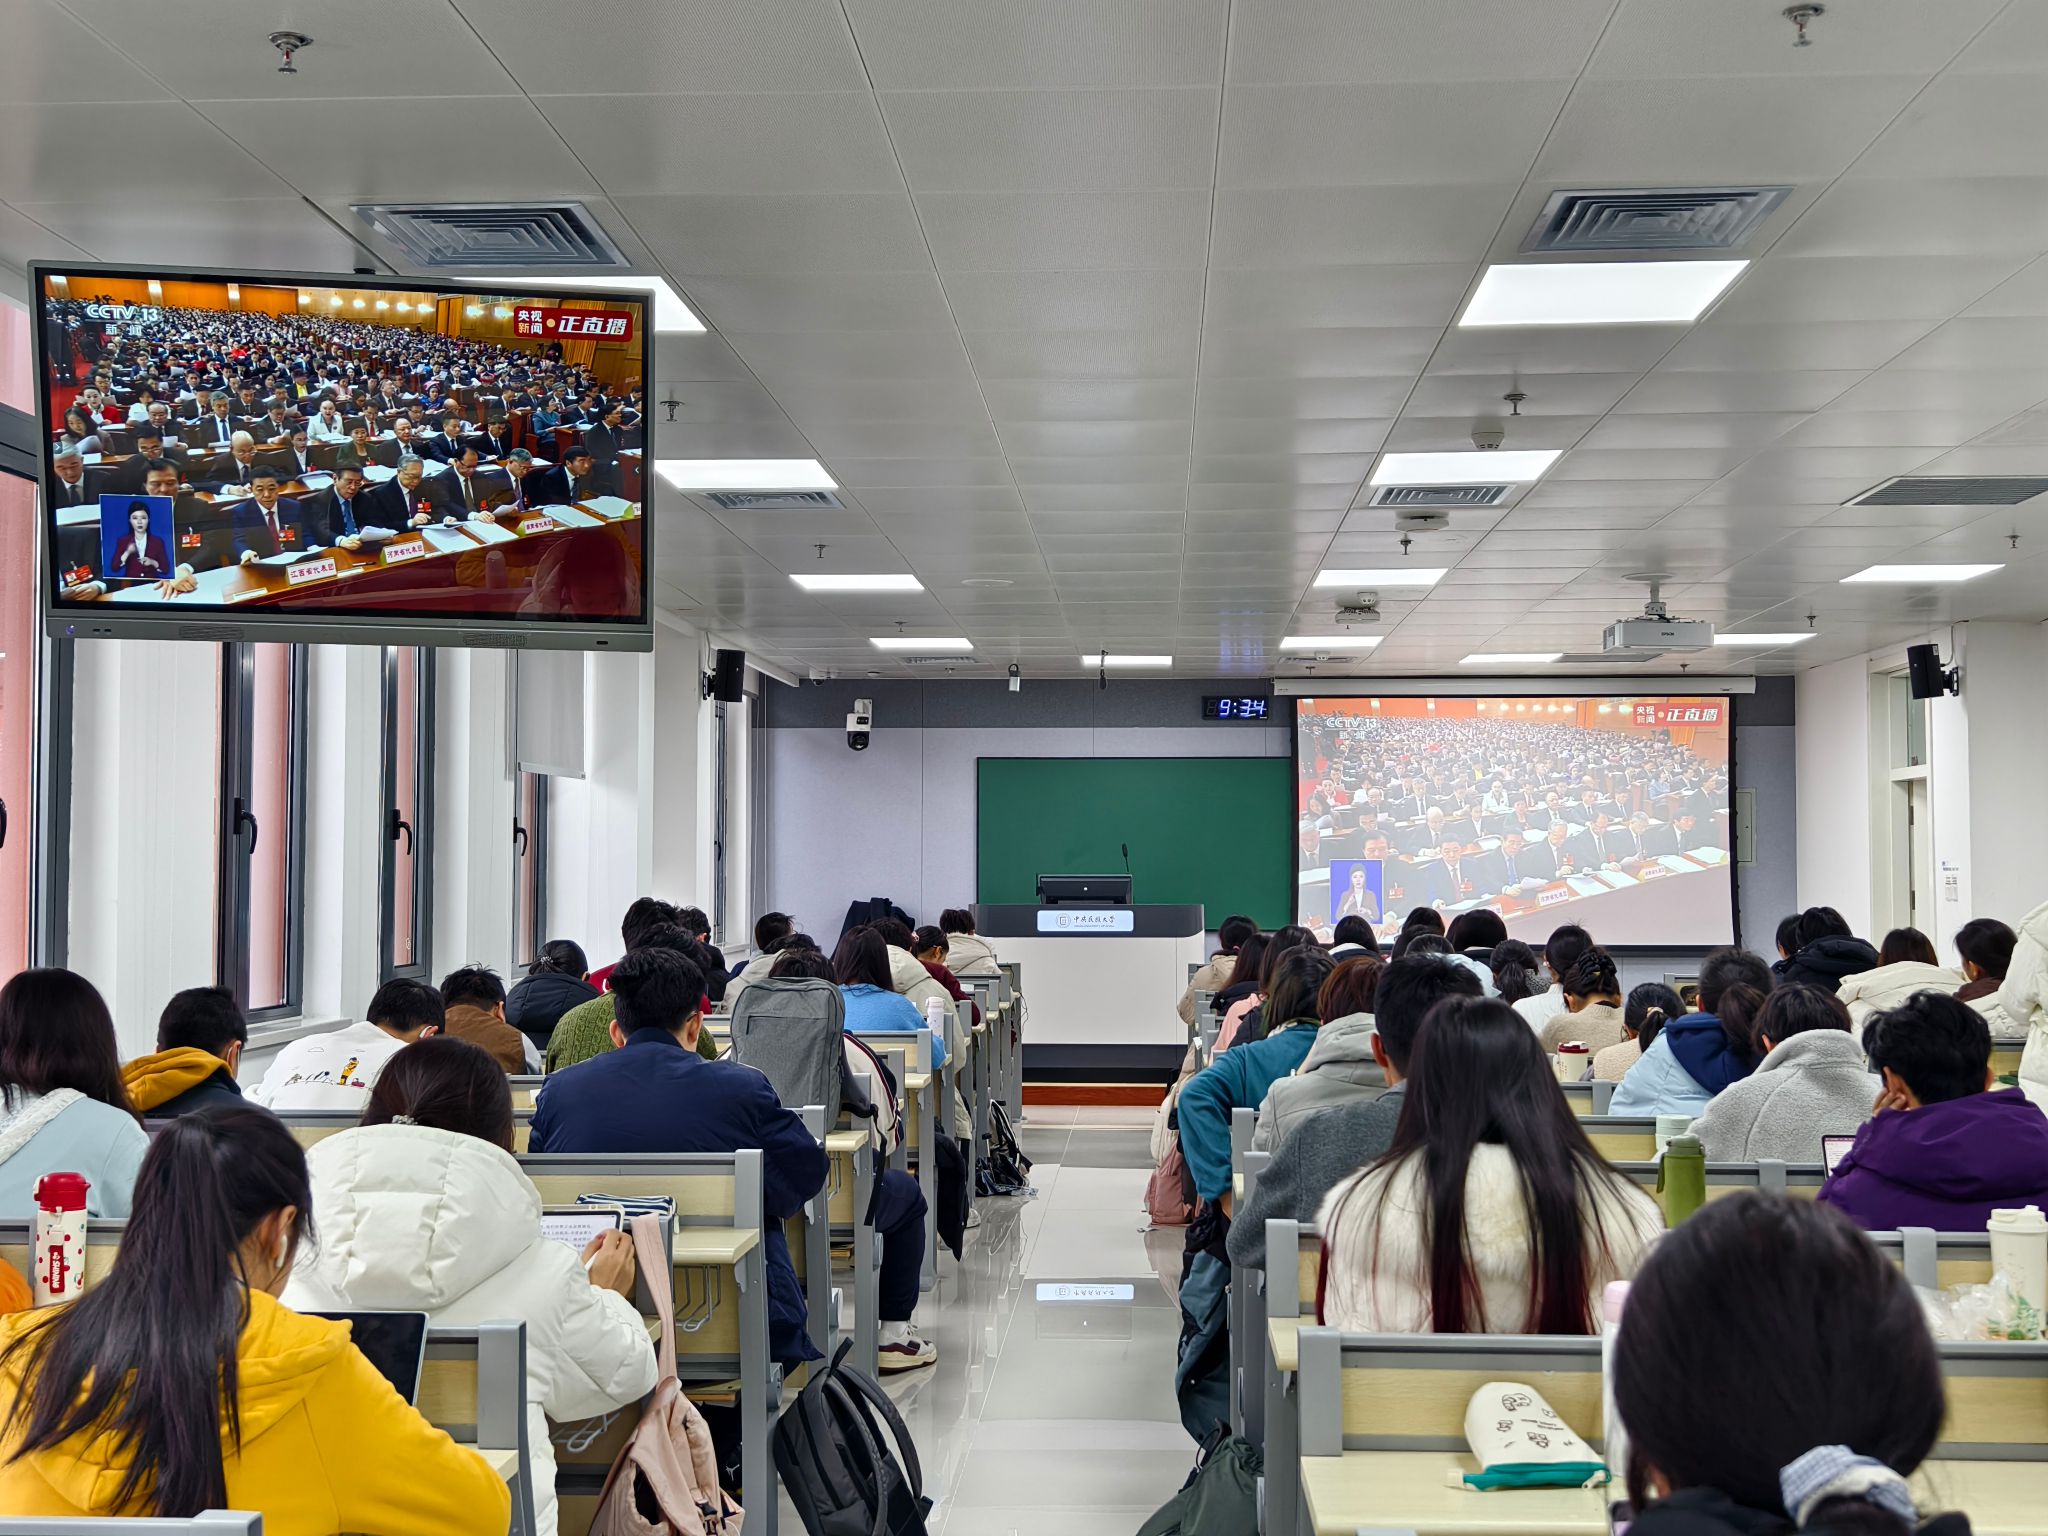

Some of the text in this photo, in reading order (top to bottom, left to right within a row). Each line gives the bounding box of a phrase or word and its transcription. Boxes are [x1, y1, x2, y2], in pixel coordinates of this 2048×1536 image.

[87, 304, 158, 321] CCTV 13
[518, 310, 542, 322] 央视
[518, 322, 543, 335] 新闻
[558, 316, 627, 335] 正直播
[290, 563, 335, 579] 江西省代表团
[1220, 699, 1265, 716] 9:34
[1636, 706, 1655, 715] 央视
[1637, 715, 1656, 724] 新闻
[1666, 708, 1719, 721] 正直播
[1326, 717, 1361, 728] CCTV
